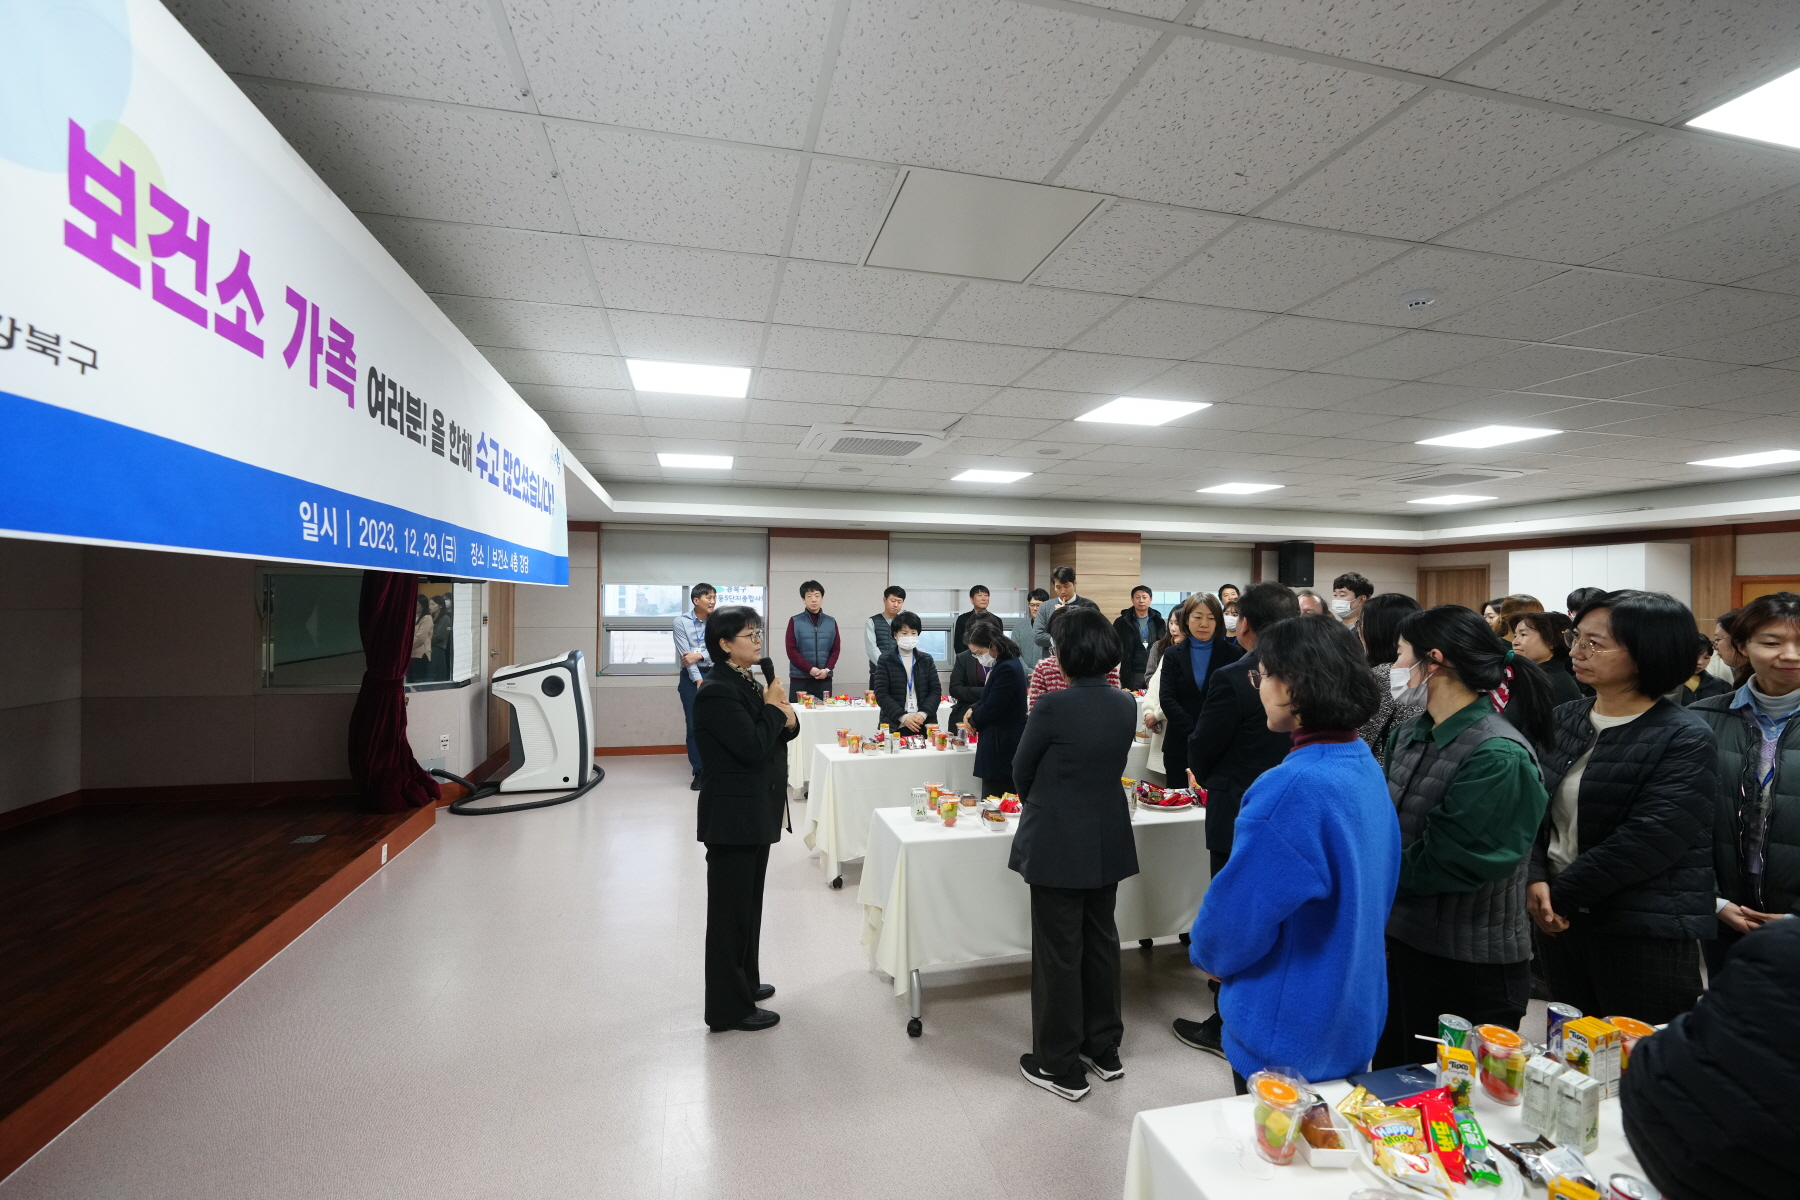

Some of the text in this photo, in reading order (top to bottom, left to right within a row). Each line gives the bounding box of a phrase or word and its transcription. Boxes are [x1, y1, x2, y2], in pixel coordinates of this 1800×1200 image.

[63, 117, 265, 359] 보건소
[282, 284, 358, 410] 가족
[367, 366, 427, 447] 여러분!
[431, 408, 446, 458] 올
[476, 431, 500, 488] 수고
[502, 448, 555, 516] 많으셨습니다!
[299, 500, 338, 545] 일시
[358, 516, 398, 553] 2023.
[404, 527, 420, 557] 12.
[470, 542, 485, 566] 장소
[491, 547, 509, 570] 보건소
[510, 551, 519, 573] 4층
[519, 554, 529, 574] 강당
[715, 594, 763, 603] 동5단지종합사
[1375, 1124, 1415, 1138] Happy
[1431, 1120, 1455, 1152] 뽀또
[1460, 1122, 1484, 1147] 롯샌
